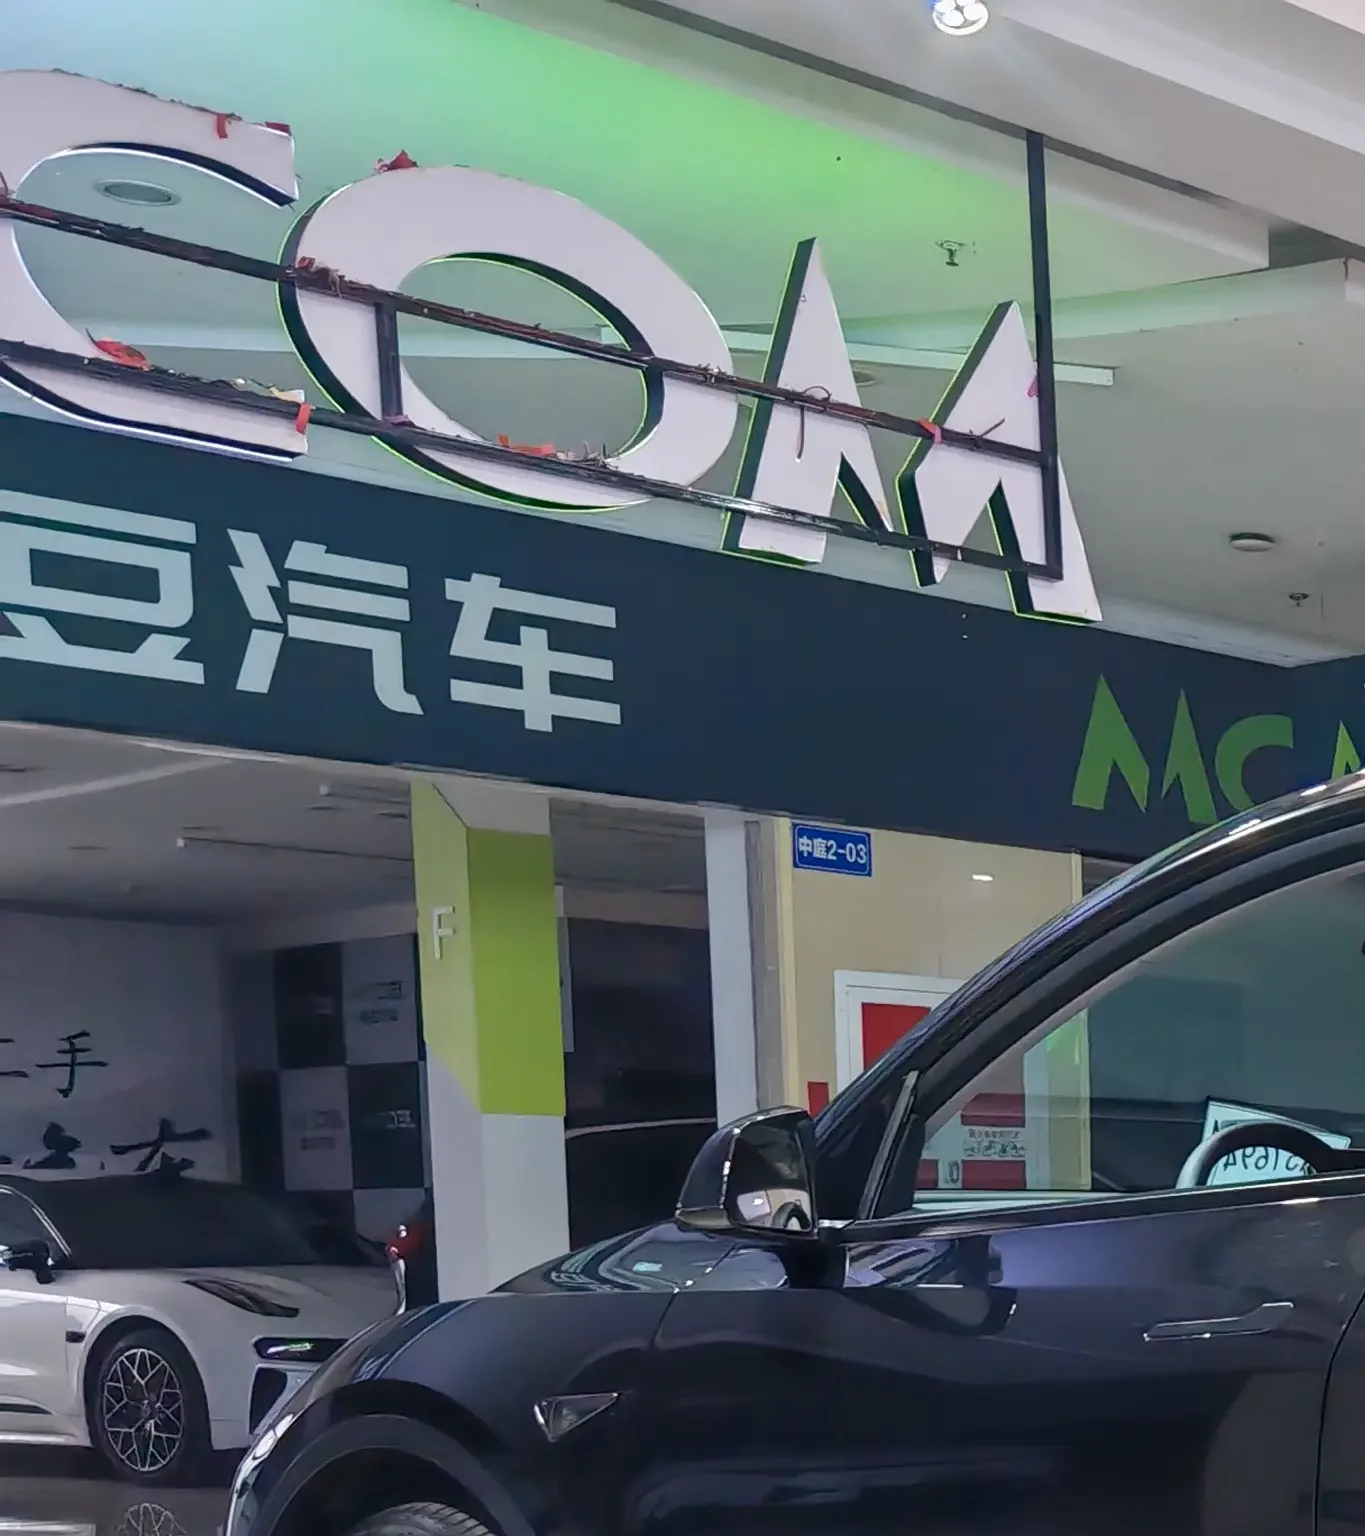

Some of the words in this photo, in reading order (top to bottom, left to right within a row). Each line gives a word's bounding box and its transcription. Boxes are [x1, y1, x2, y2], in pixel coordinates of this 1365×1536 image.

[0, 489, 622, 733] 豆汽车
[798, 835, 867, 864] 中庭2-03
[432, 905, 456, 960] F
